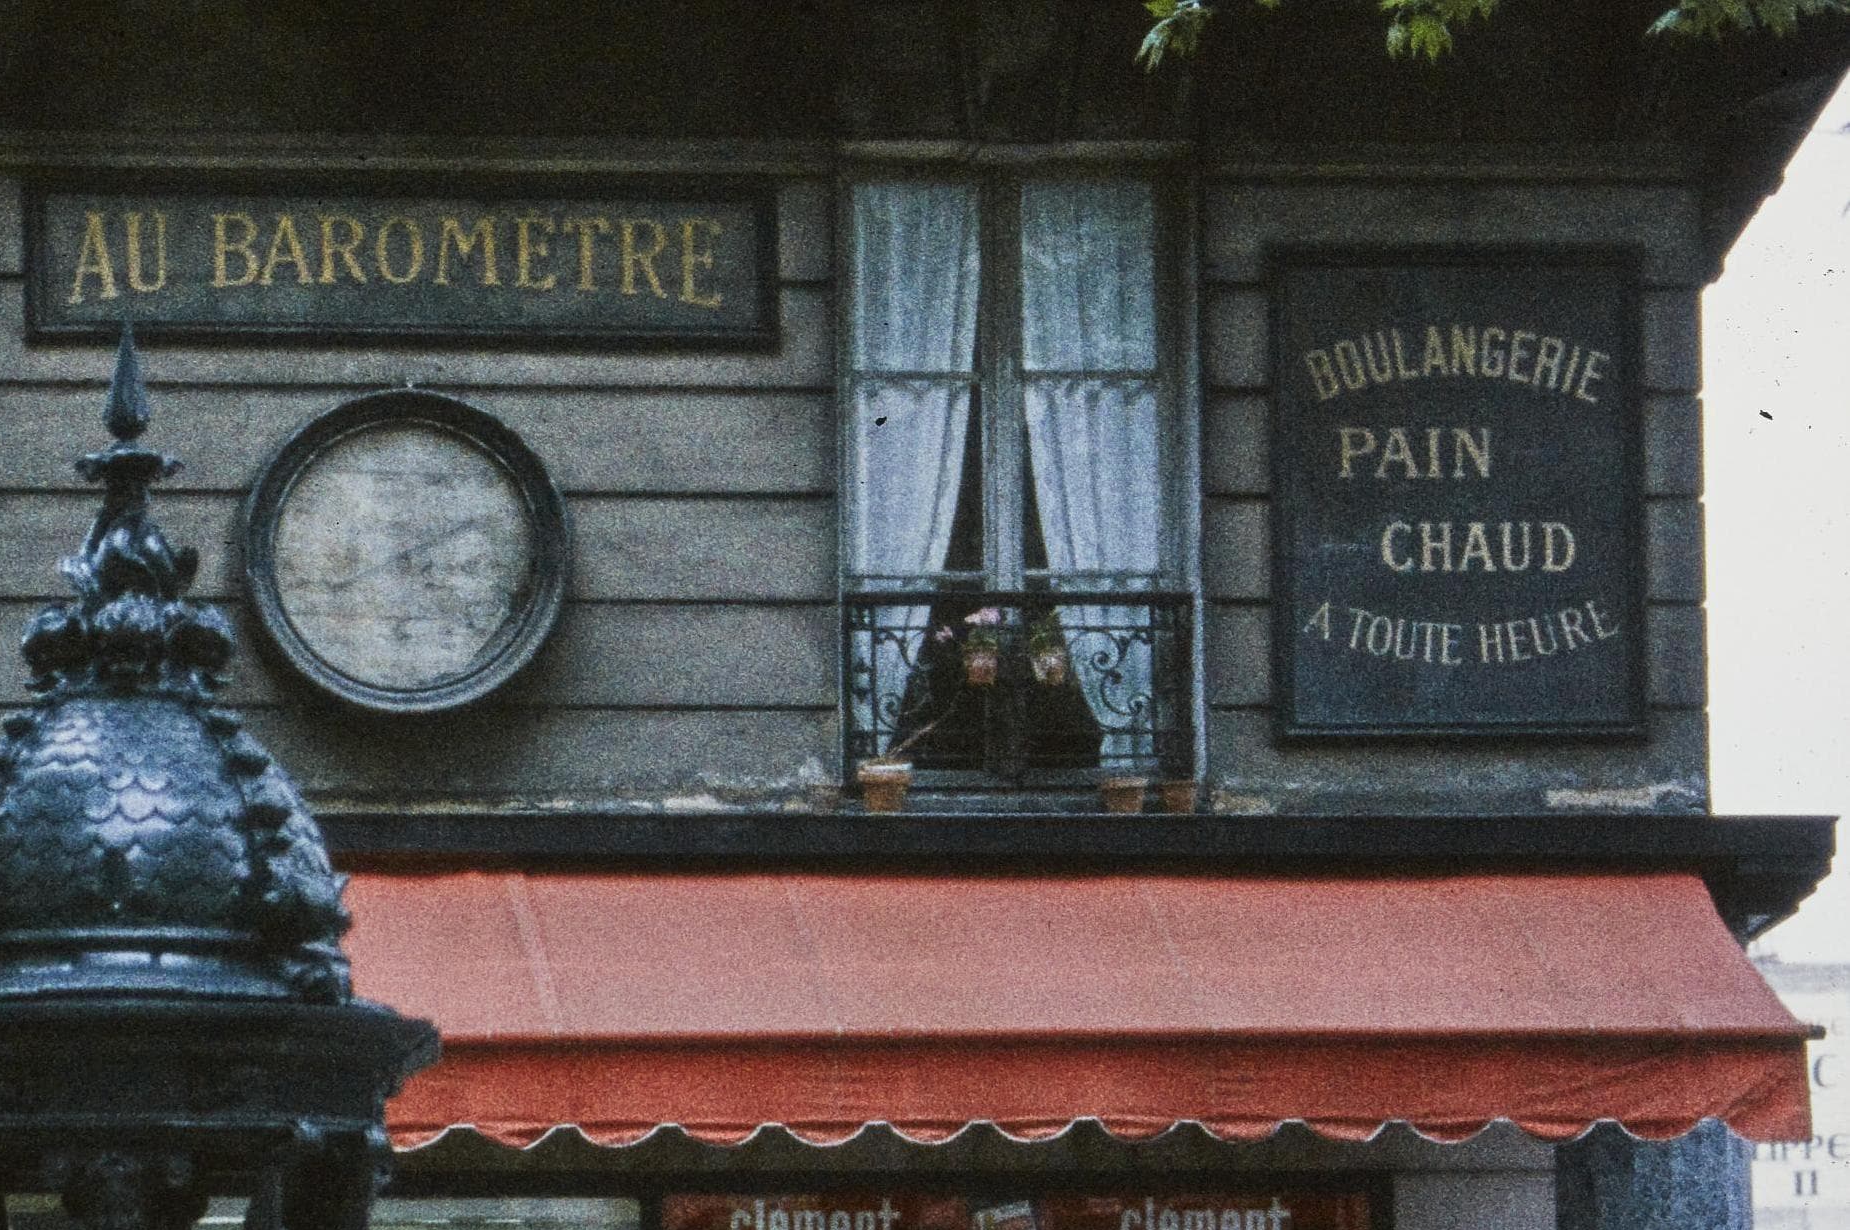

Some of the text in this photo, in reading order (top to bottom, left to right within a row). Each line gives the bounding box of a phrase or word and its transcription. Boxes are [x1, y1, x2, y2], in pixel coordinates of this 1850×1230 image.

[66, 210, 725, 308] AU BAROMETRE
[1304, 324, 1612, 404] BOULANGERIE
[1338, 426, 1491, 480] PAIN
[1380, 520, 1577, 573] CHAUD
[1349, 607, 1464, 667] TOUTE
[1477, 600, 1620, 665] HEURE
